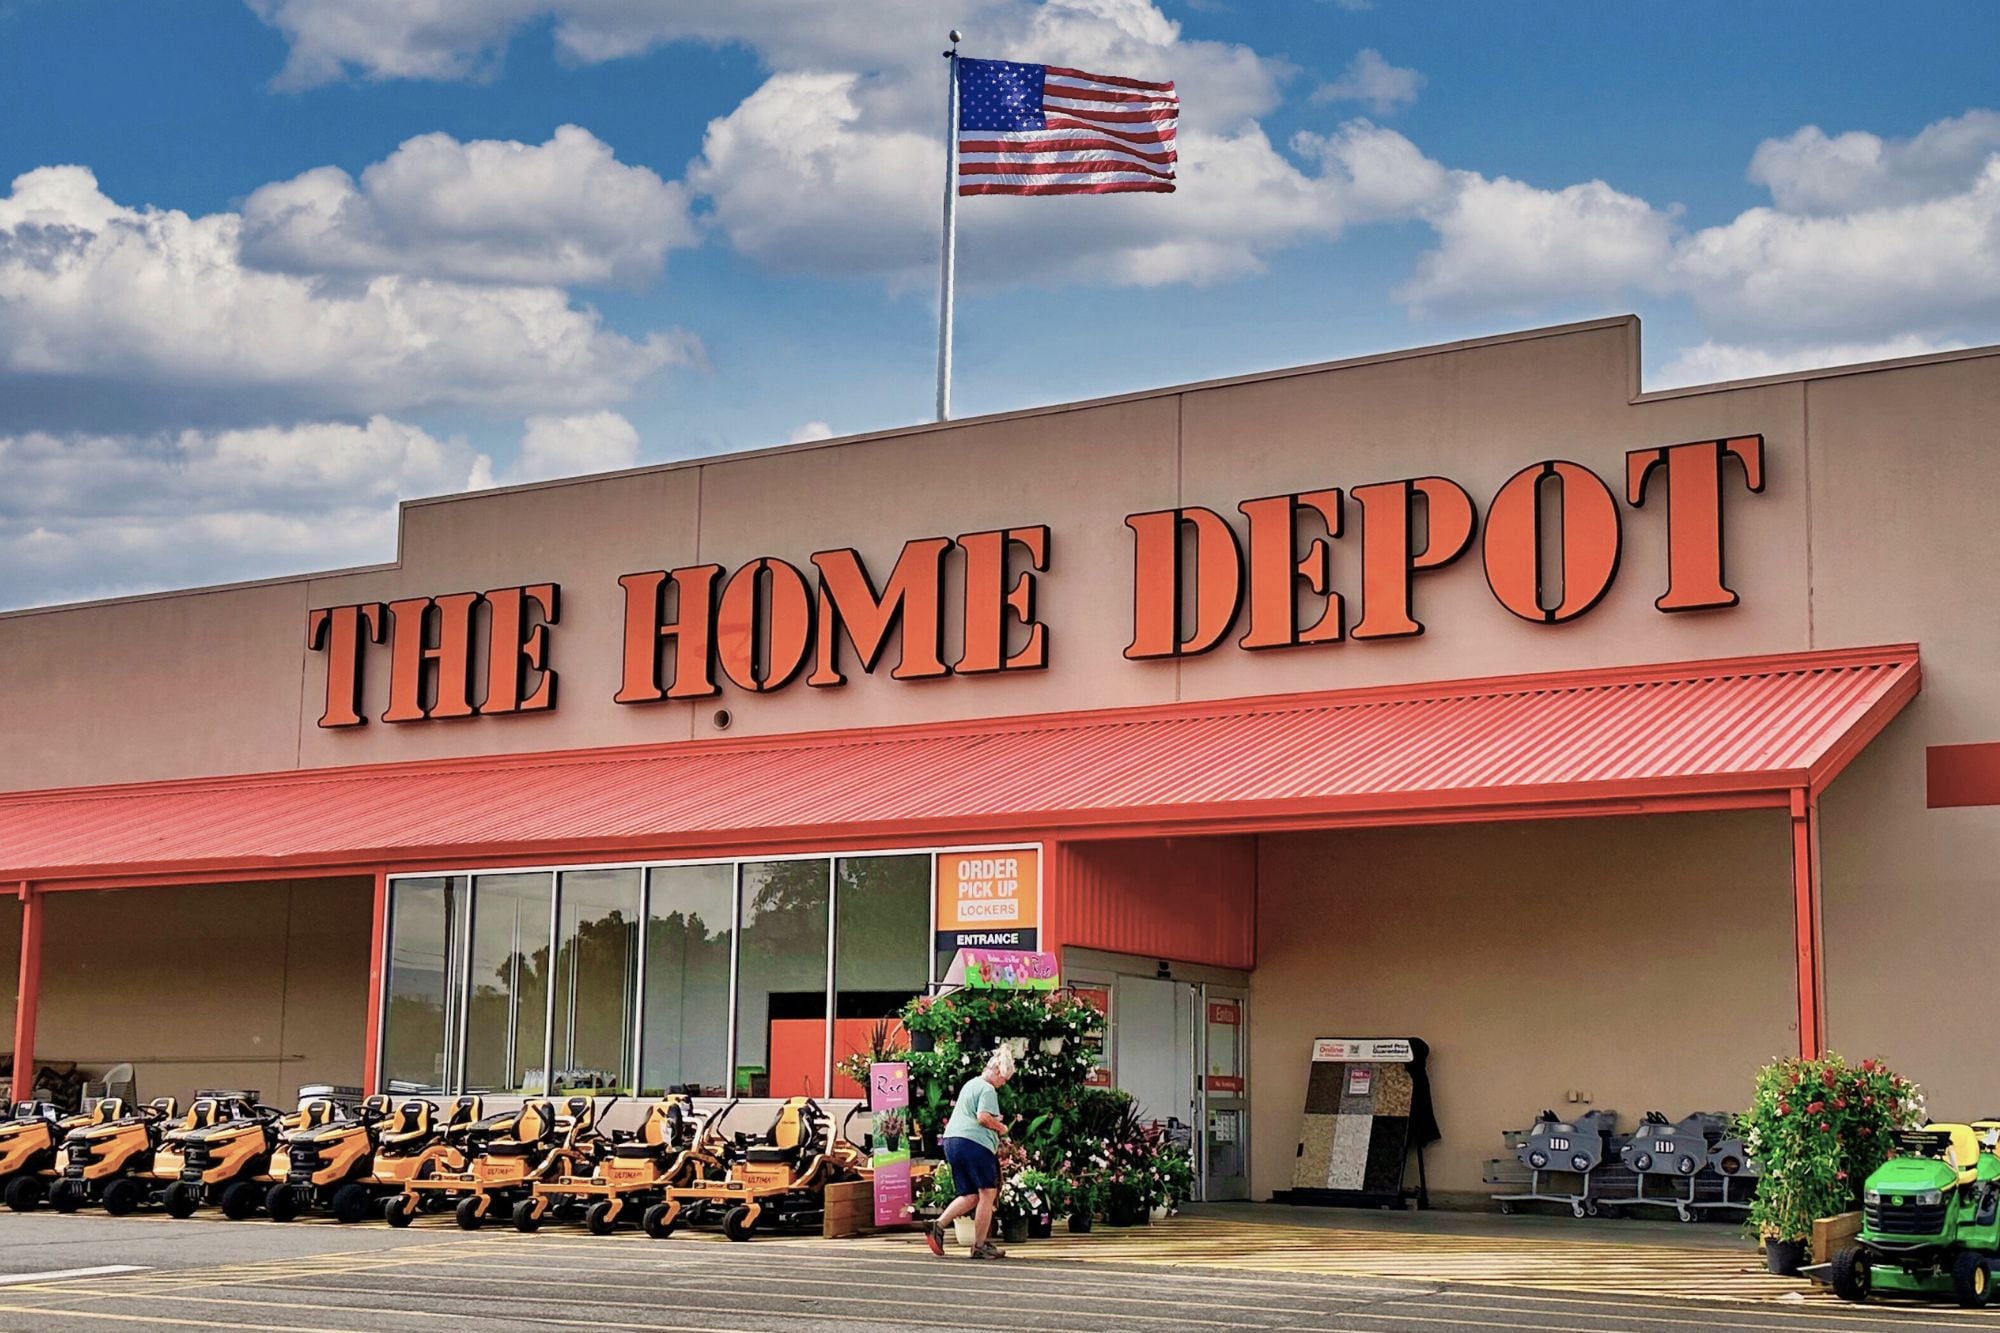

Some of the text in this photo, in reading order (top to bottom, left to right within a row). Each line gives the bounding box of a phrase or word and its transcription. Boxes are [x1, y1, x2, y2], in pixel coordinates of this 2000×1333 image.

[309, 433, 1765, 728] THE HOME DEPOT
[958, 858, 1018, 880] ORDER
[958, 880, 1018, 899] PICK UP
[960, 904, 1015, 917] LOCKERS
[956, 933, 1019, 946] ENTRANCE
[1550, 1138, 1569, 1150] HD
[1655, 1141, 1674, 1152] HD
